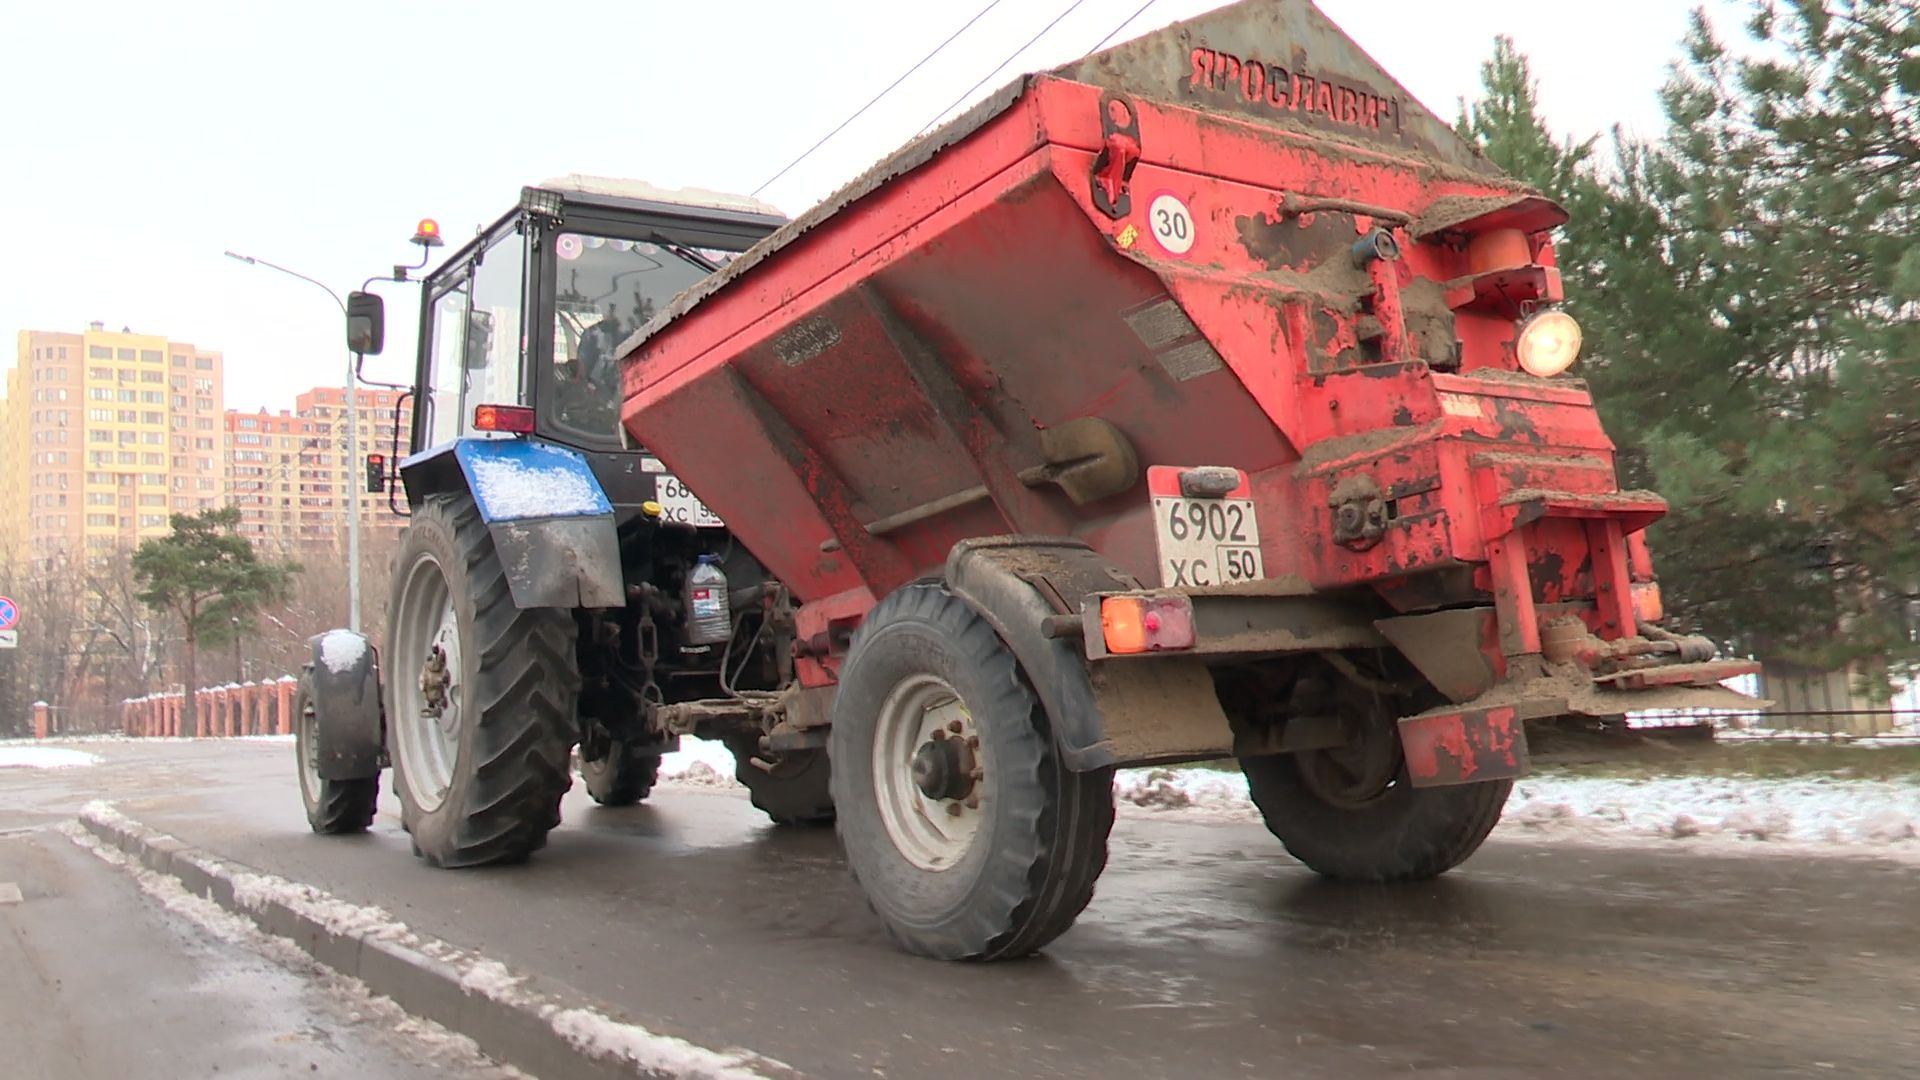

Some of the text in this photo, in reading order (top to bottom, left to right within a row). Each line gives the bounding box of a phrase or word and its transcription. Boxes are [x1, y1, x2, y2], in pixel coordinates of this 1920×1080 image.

[1157, 208, 1187, 240] 30
[1169, 501, 1246, 541] 6902
[1226, 549, 1256, 580] 50
